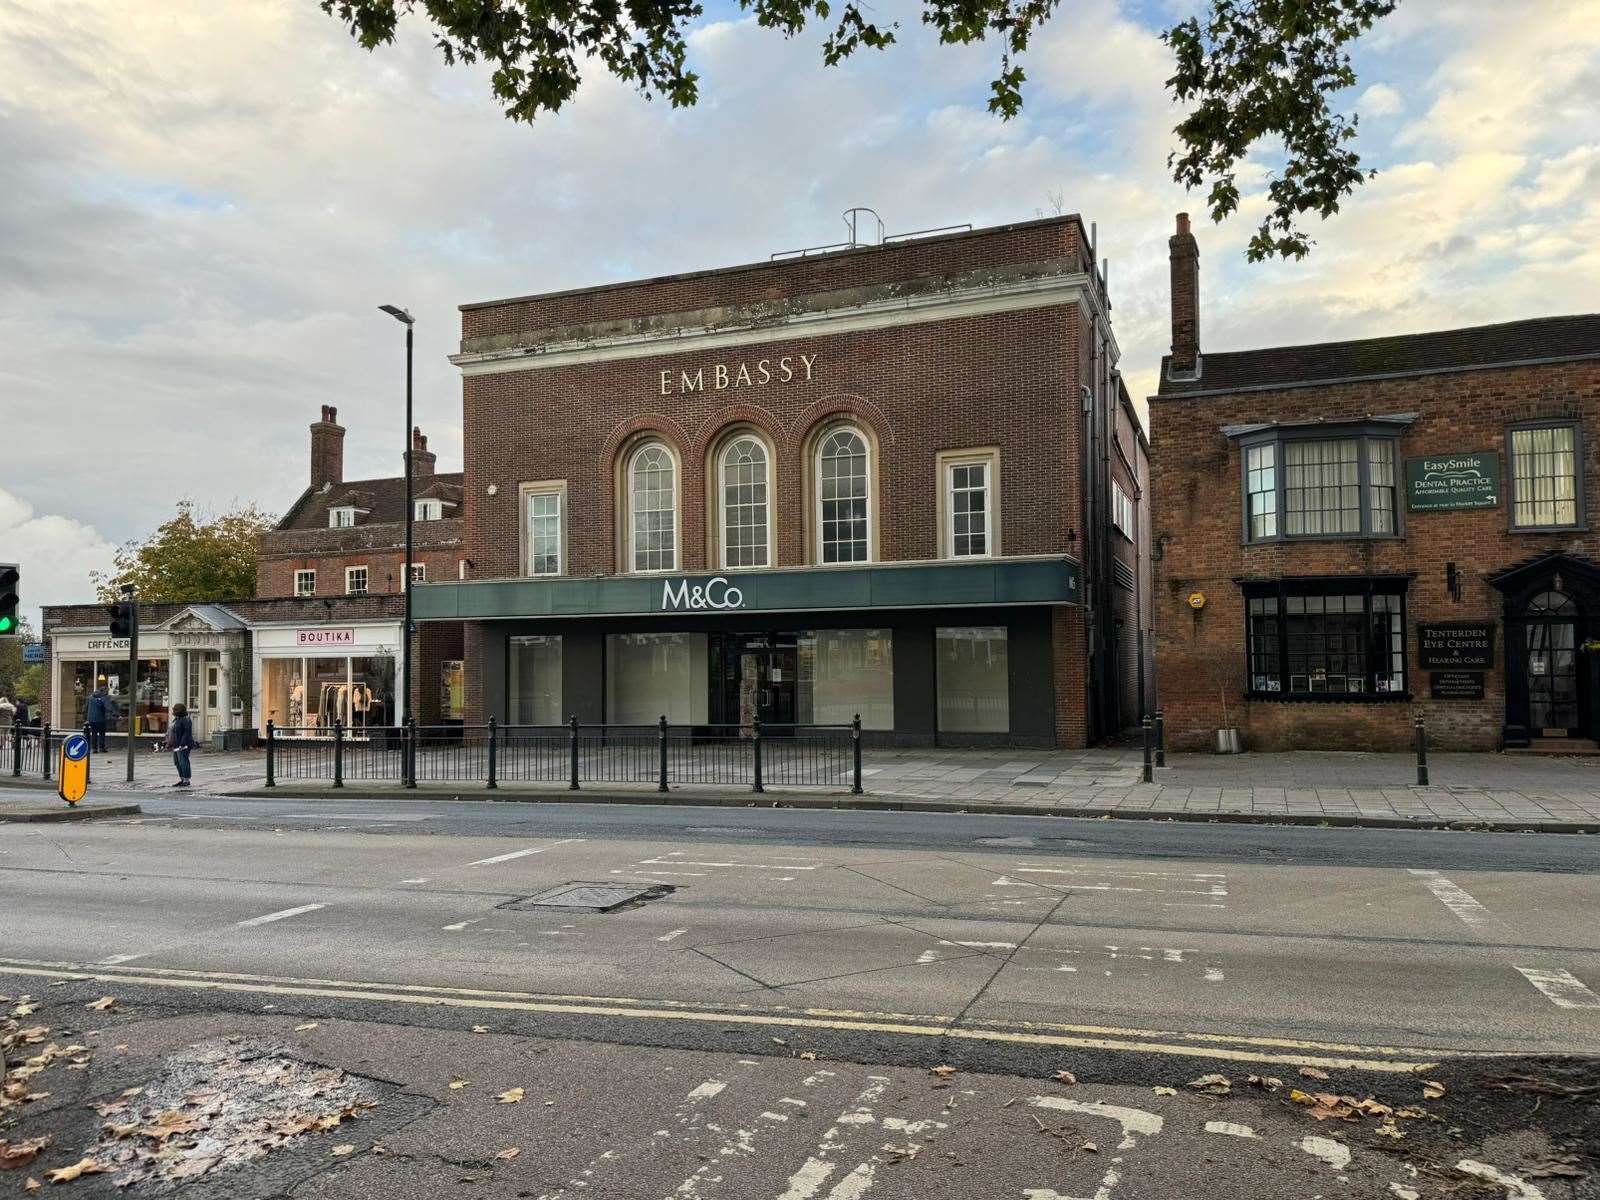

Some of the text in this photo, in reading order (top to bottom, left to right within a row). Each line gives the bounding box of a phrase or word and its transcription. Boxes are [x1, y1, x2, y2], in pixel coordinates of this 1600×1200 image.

[660, 354, 817, 395] EMBASSY
[1424, 458, 1481, 472] EasySmile
[1450, 478, 1492, 487] PRACTICE
[300, 632, 351, 642] BOUTIKA
[1424, 629, 1487, 638] TENTERDEN
[113, 640, 131, 649] NER
[1424, 639, 1489, 648] EYE CENTRE
